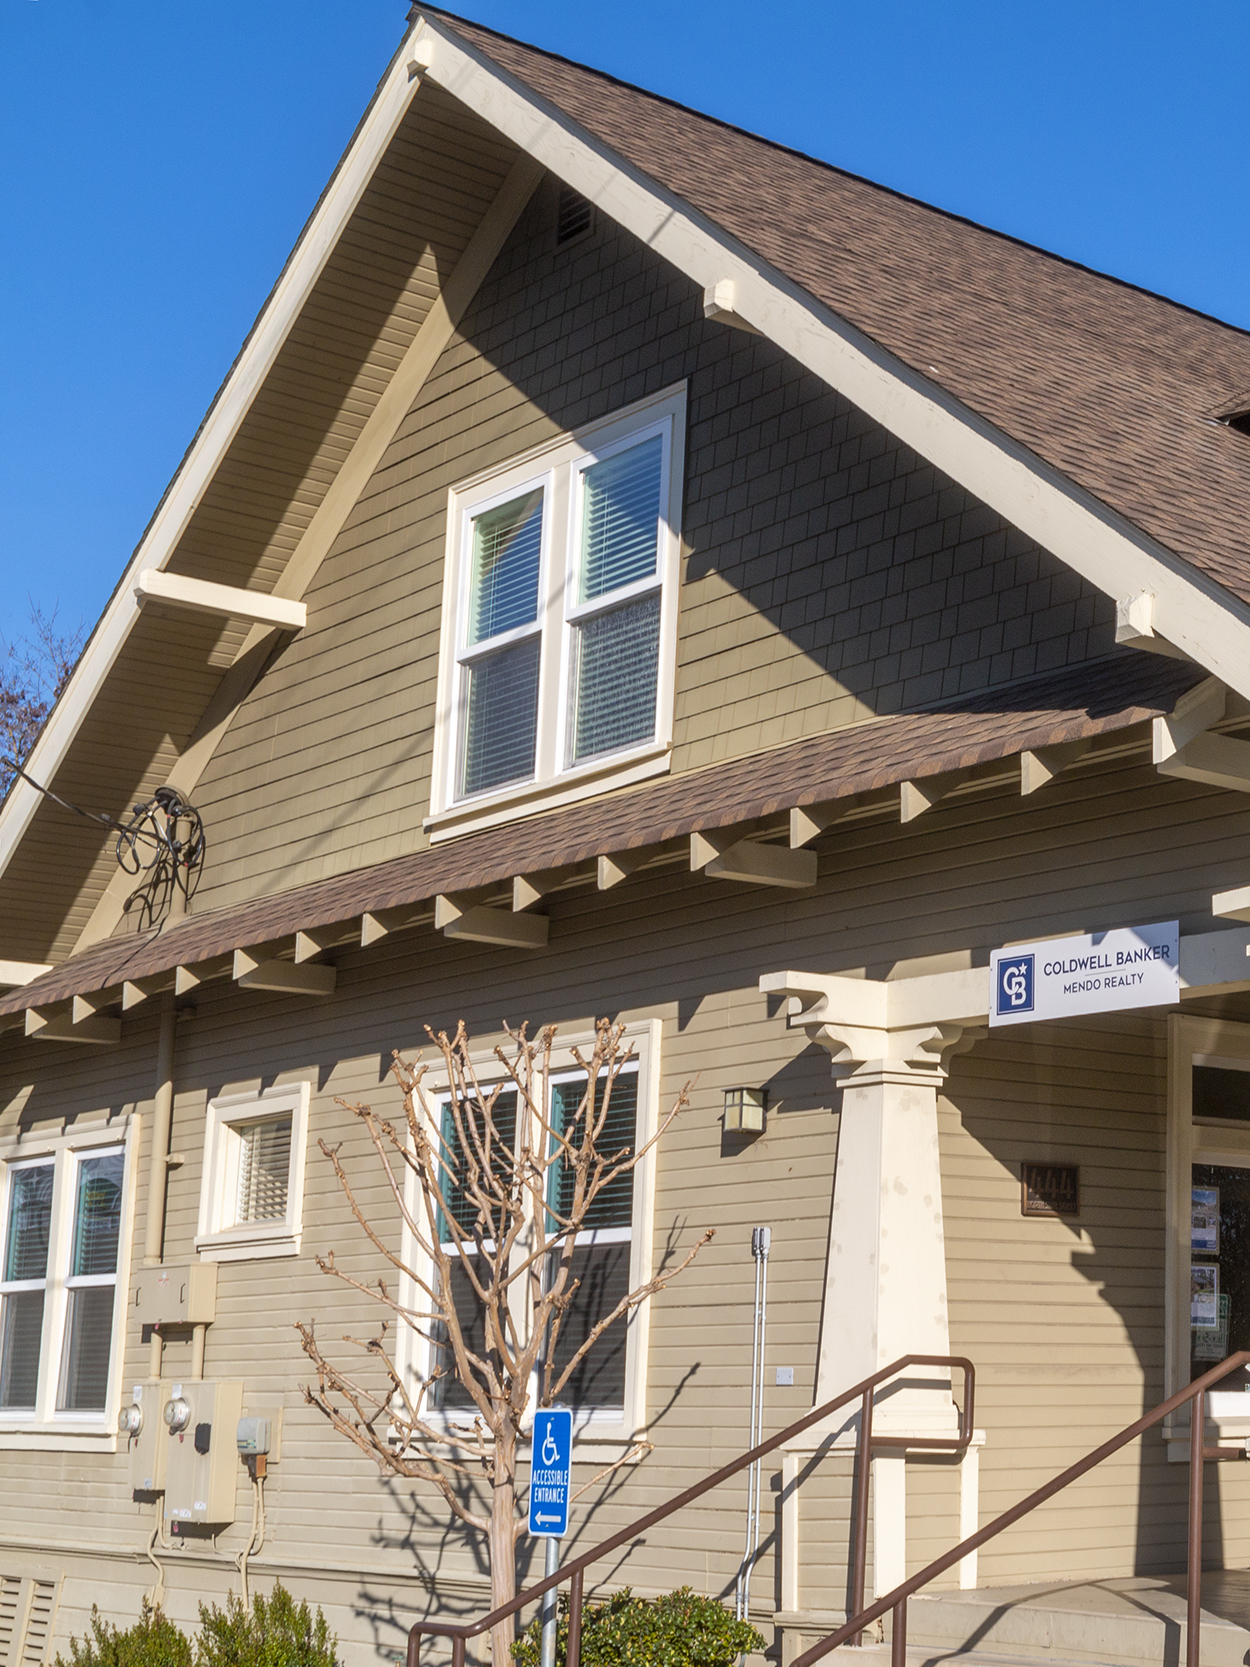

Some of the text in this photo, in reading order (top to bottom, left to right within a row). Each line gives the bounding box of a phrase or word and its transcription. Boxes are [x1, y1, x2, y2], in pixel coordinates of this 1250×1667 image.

[1043, 944, 1170, 977] COLDWELL BANKER
[1063, 972, 1145, 994] MENDO REALTY
[532, 1470, 568, 1485] ACCESSIBLE
[534, 1487, 564, 1503] ENTRANCE
